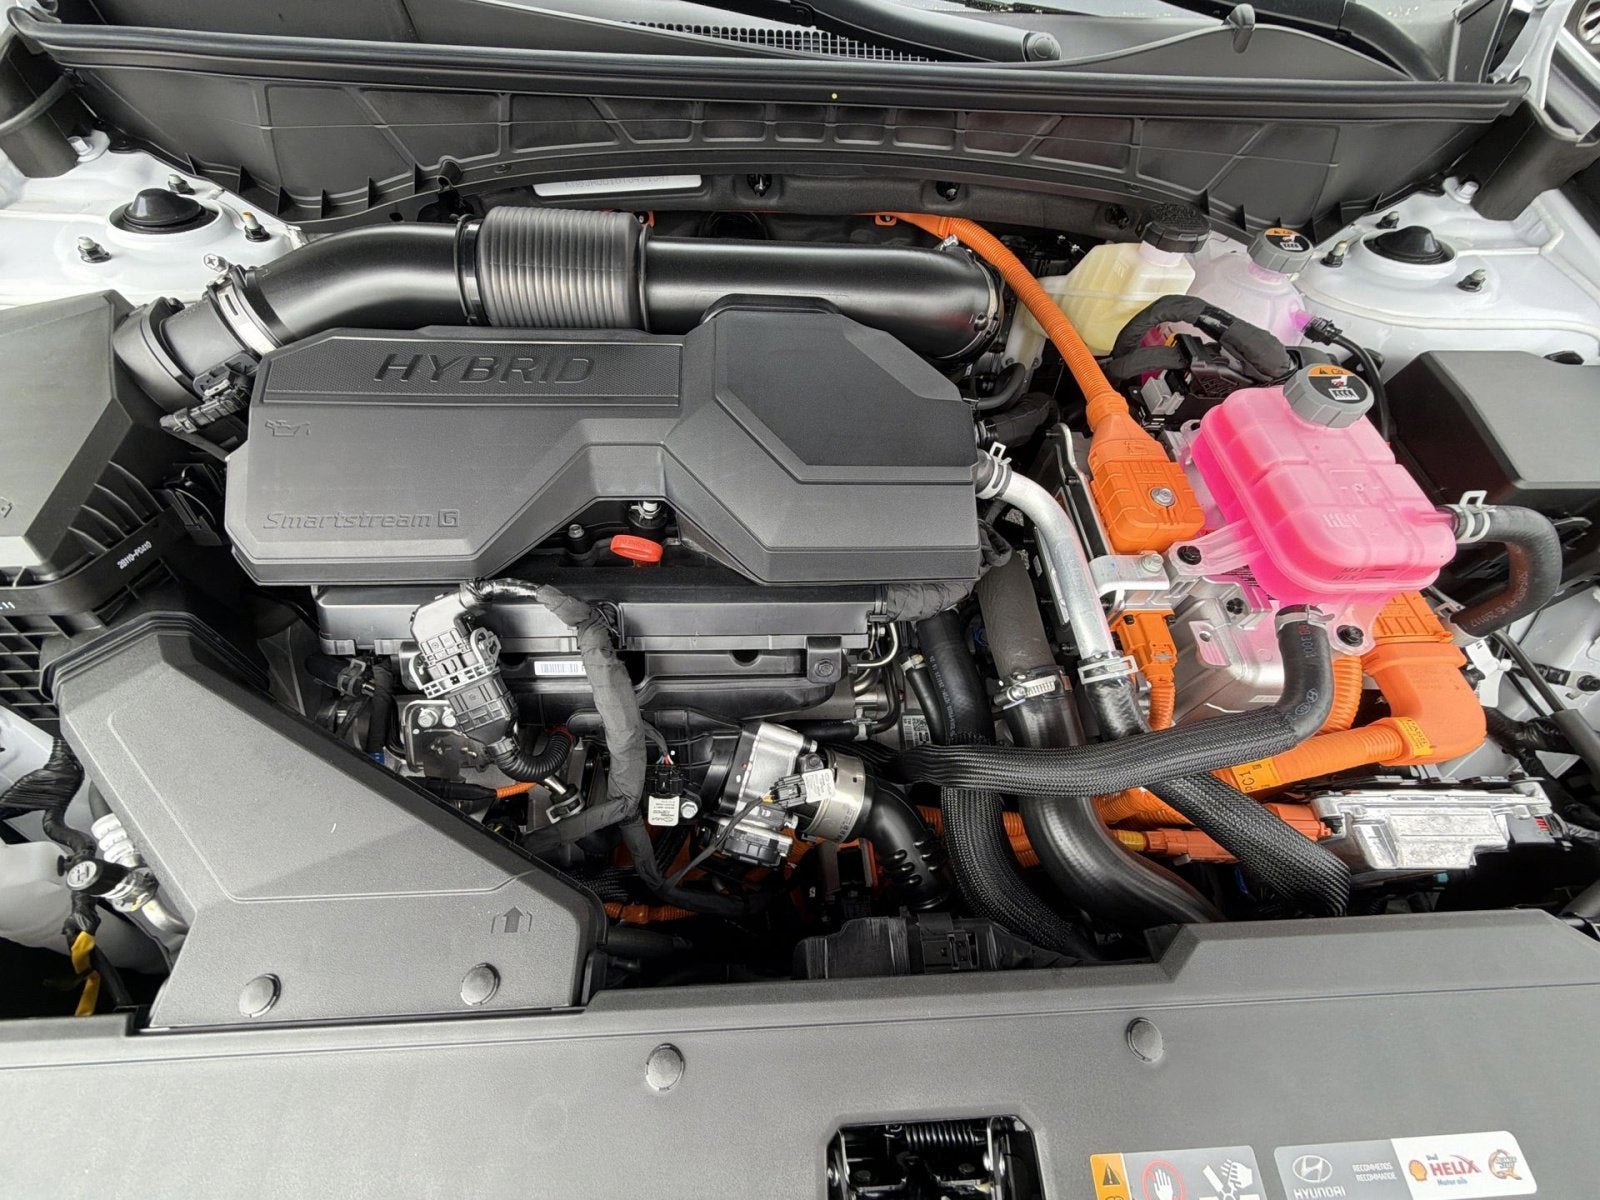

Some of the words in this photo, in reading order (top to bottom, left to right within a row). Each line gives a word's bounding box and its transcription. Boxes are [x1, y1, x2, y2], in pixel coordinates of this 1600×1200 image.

[373, 353, 595, 384] HYBRID
[262, 511, 433, 530] Smartstream
[1429, 1160, 1481, 1176] HELIX
[1293, 1185, 1346, 1200] HYUNDAI
